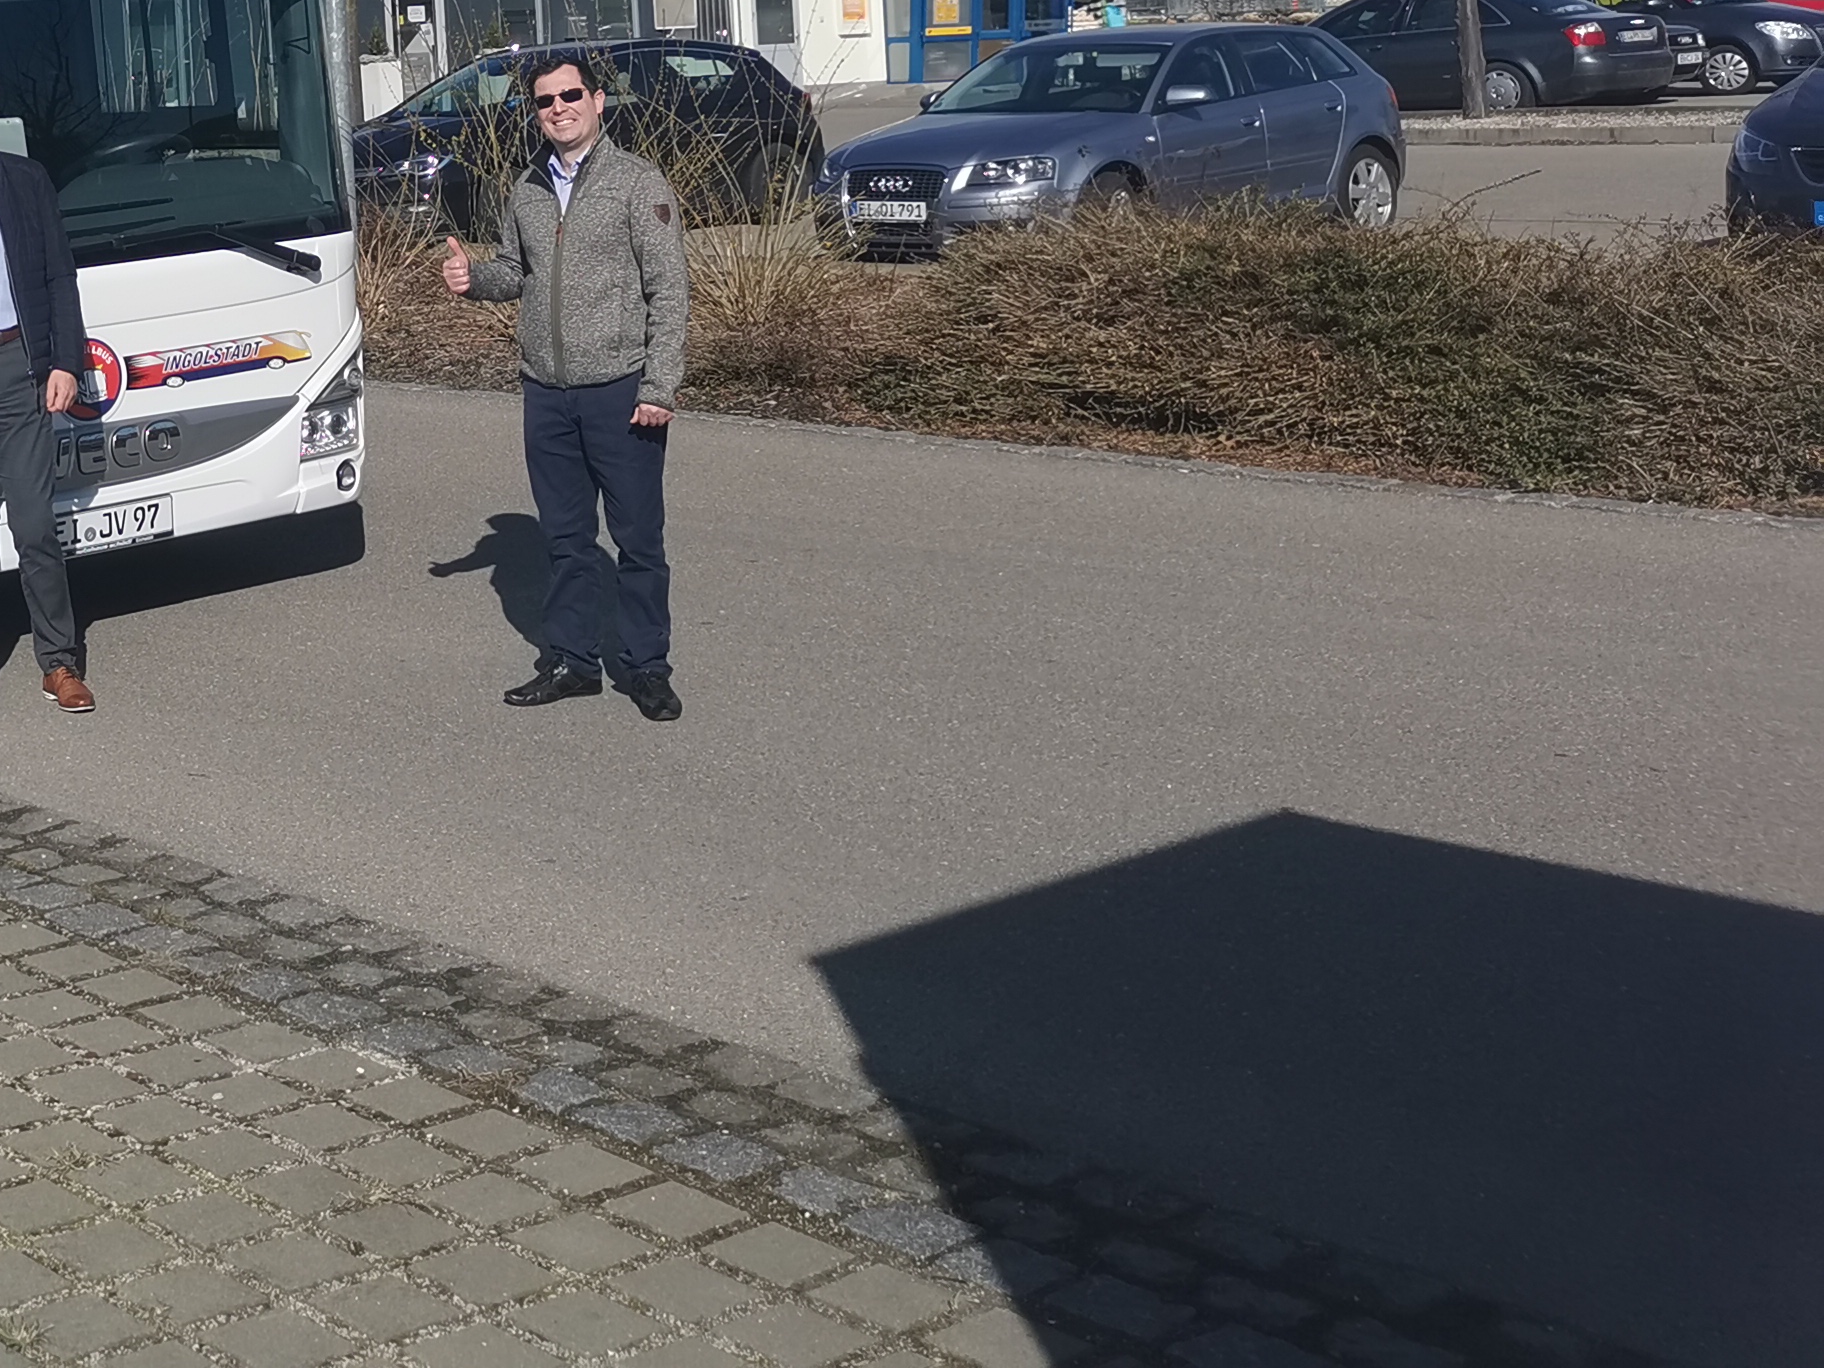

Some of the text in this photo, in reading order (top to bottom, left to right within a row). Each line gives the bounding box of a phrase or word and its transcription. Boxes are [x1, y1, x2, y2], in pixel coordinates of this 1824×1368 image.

[898, 203, 923, 218] 791
[163, 340, 263, 372] INGOLSTADT
[99, 508, 127, 539] JV
[133, 502, 160, 533] 97
